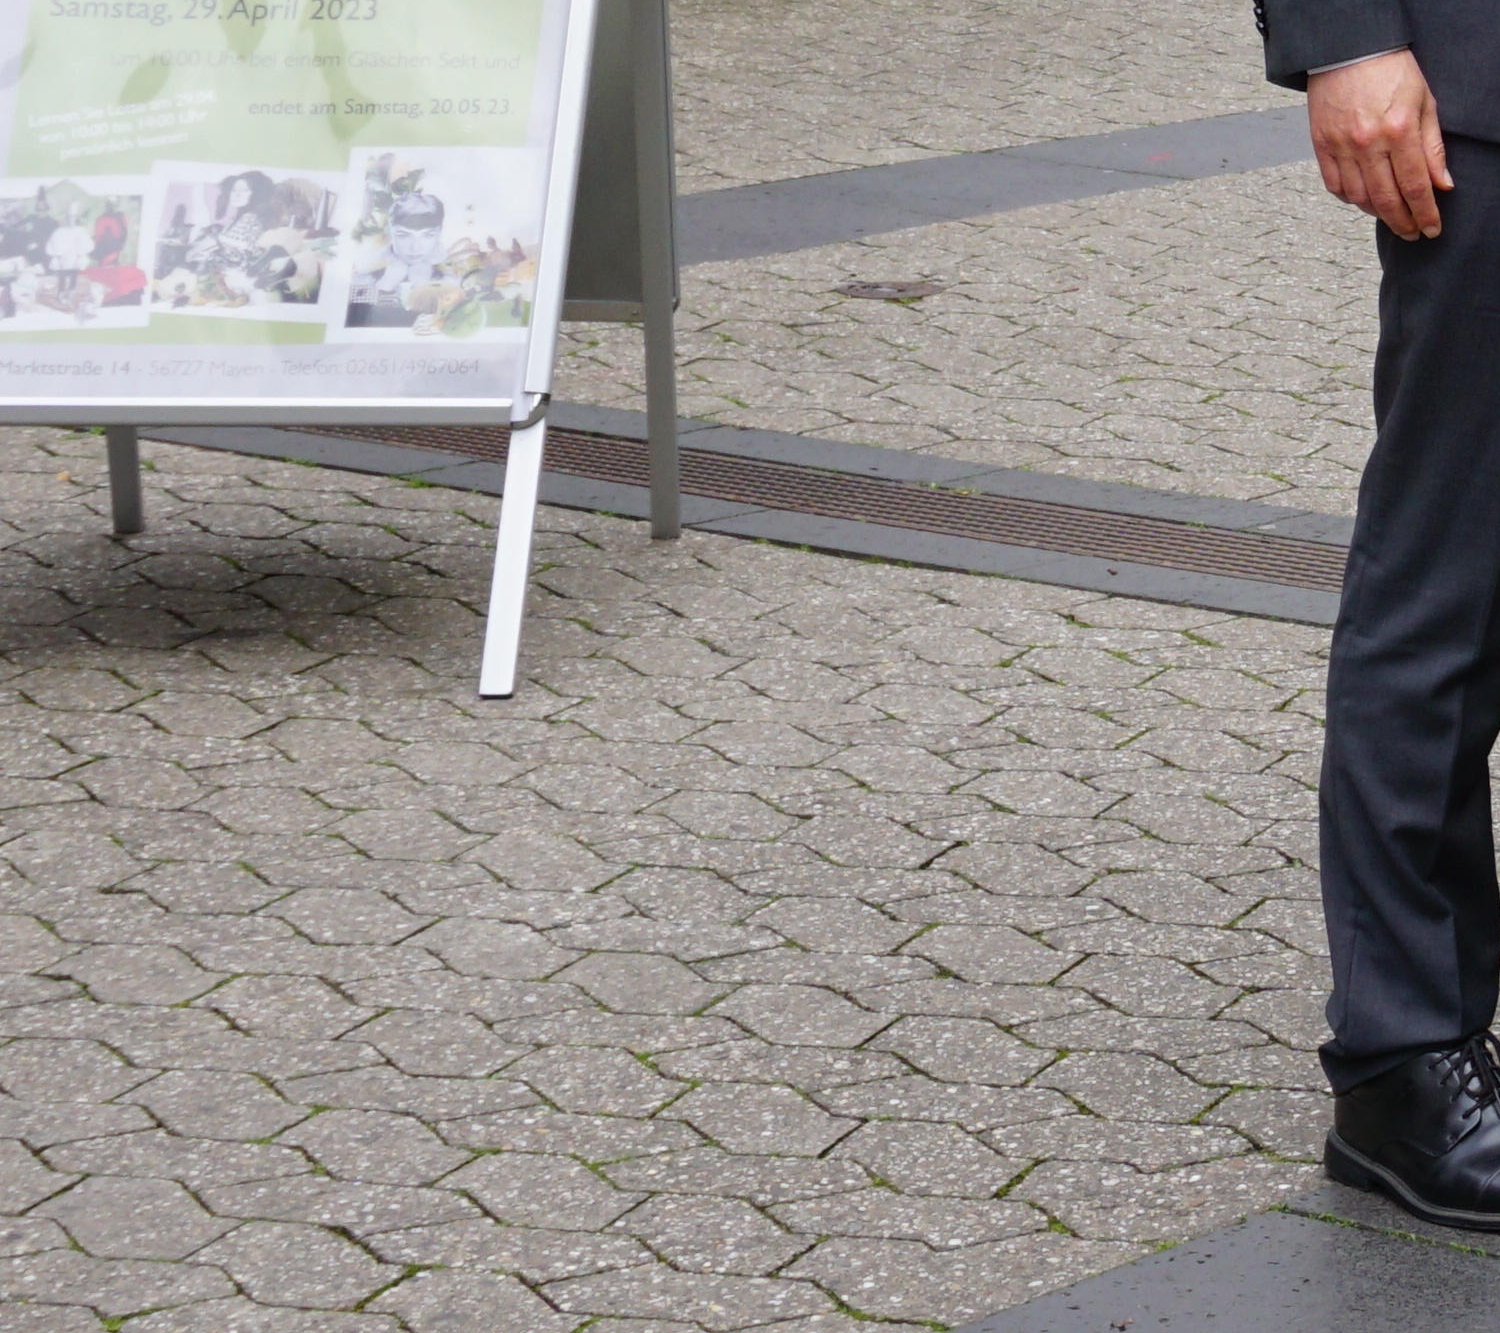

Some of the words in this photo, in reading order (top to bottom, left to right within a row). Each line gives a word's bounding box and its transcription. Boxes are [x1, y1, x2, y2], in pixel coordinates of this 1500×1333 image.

[284, 53, 341, 69] einem
[347, 49, 431, 69] Gläschen
[438, 51, 483, 70] Sekt
[483, 52, 521, 71] und
[248, 98, 303, 116] endet
[309, 101, 337, 115] am
[344, 97, 424, 119] Samstag,
[429, 97, 515, 116] 20.05.23.
[0, 359, 103, 377] Marktstraße
[111, 360, 131, 376] 14
[149, 359, 203, 377] 56727
[208, 360, 264, 379] Mayen
[281, 359, 342, 376] Telefon:
[345, 358, 480, 376] 02651/4967064
